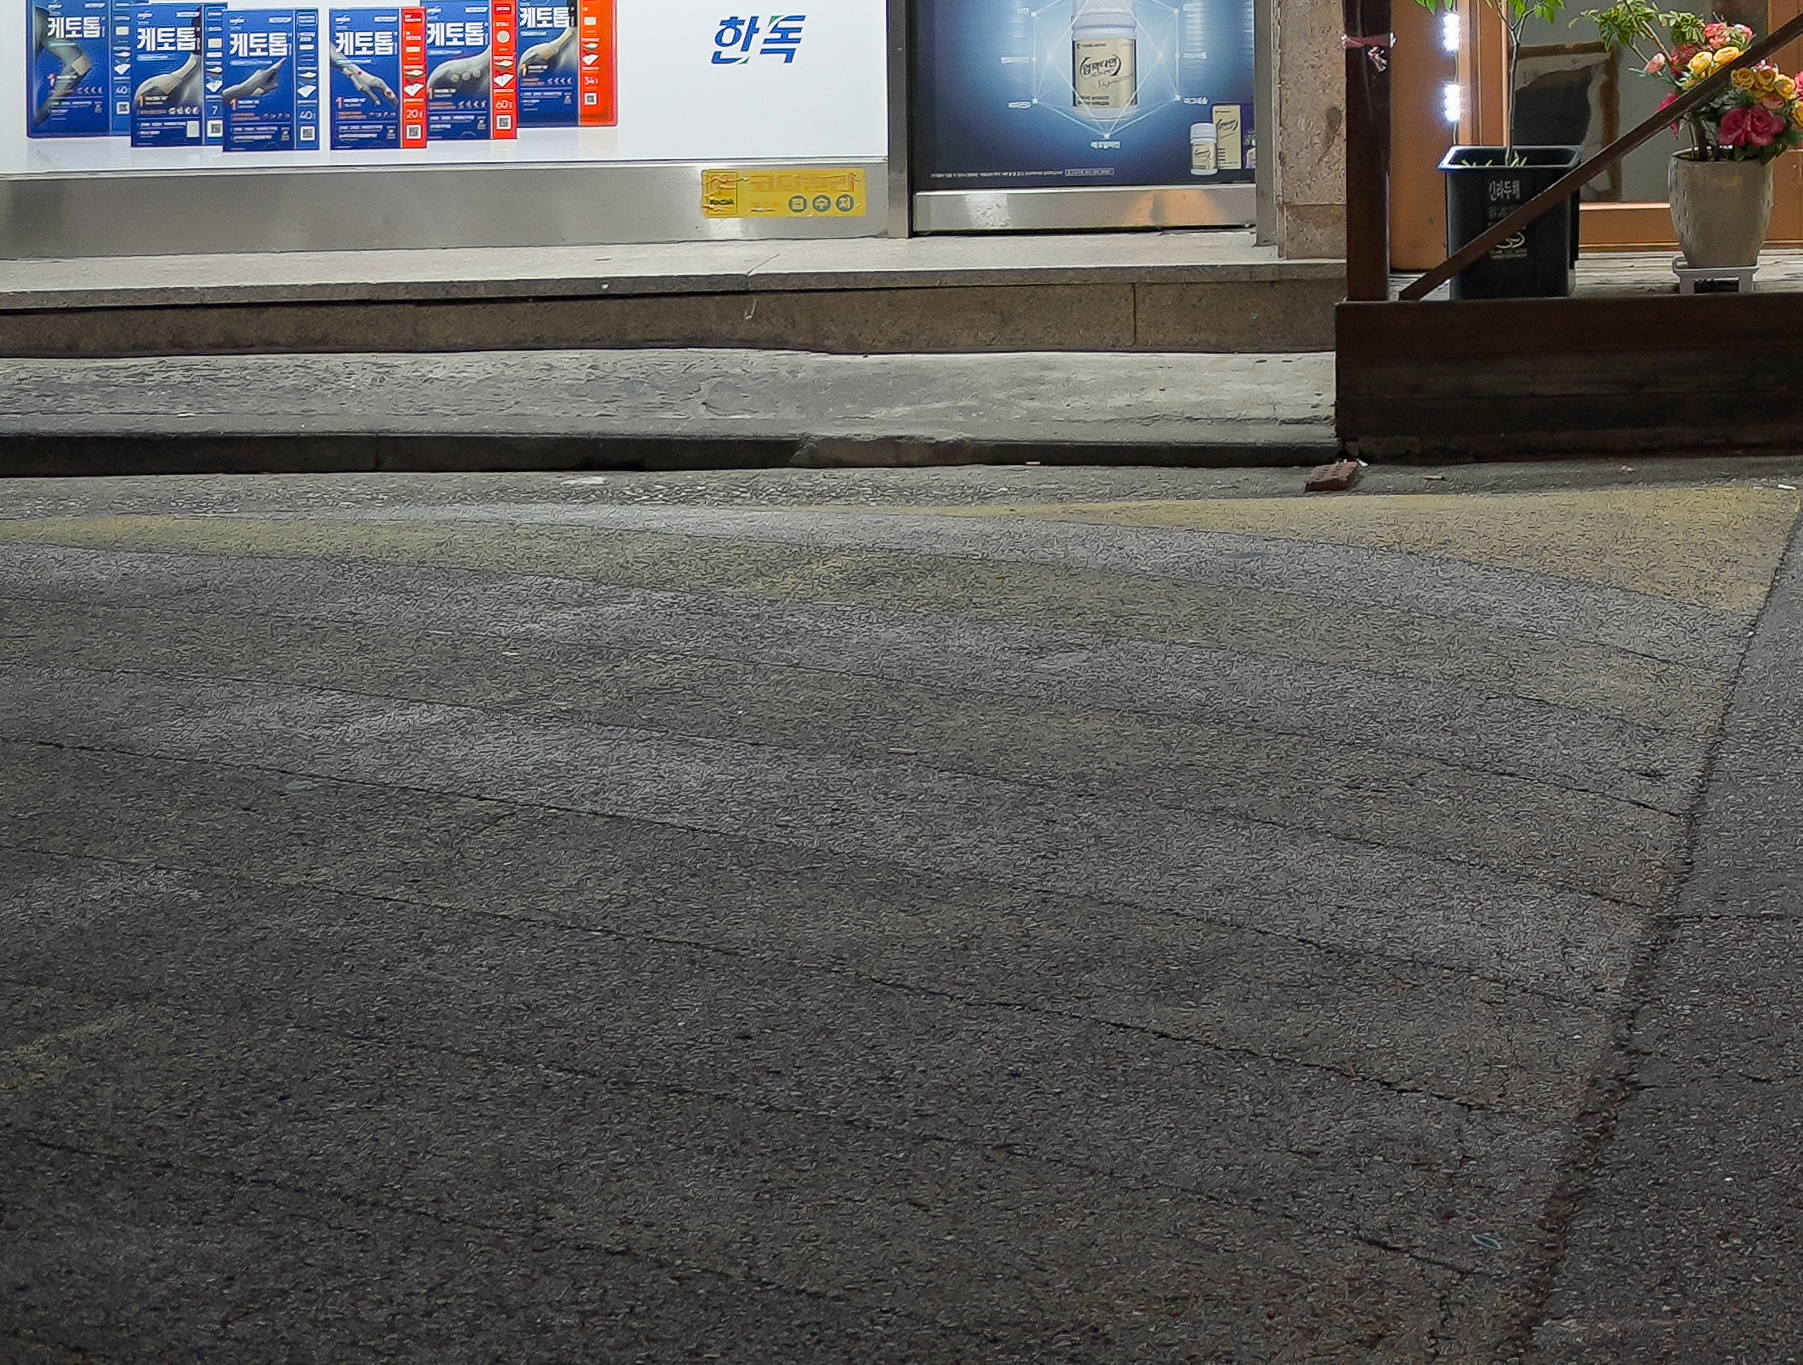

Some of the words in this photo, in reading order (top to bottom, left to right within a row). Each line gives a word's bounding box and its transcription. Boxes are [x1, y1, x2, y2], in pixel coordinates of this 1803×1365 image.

[48, 17, 100, 39] 케토톱
[520, 7, 570, 28] 케토톱
[136, 28, 197, 51] 케토톱
[230, 33, 289, 57] 케토톱
[336, 31, 394, 55] 케토톱
[426, 23, 485, 46] 케토톱
[710, 15, 807, 64] 한독
